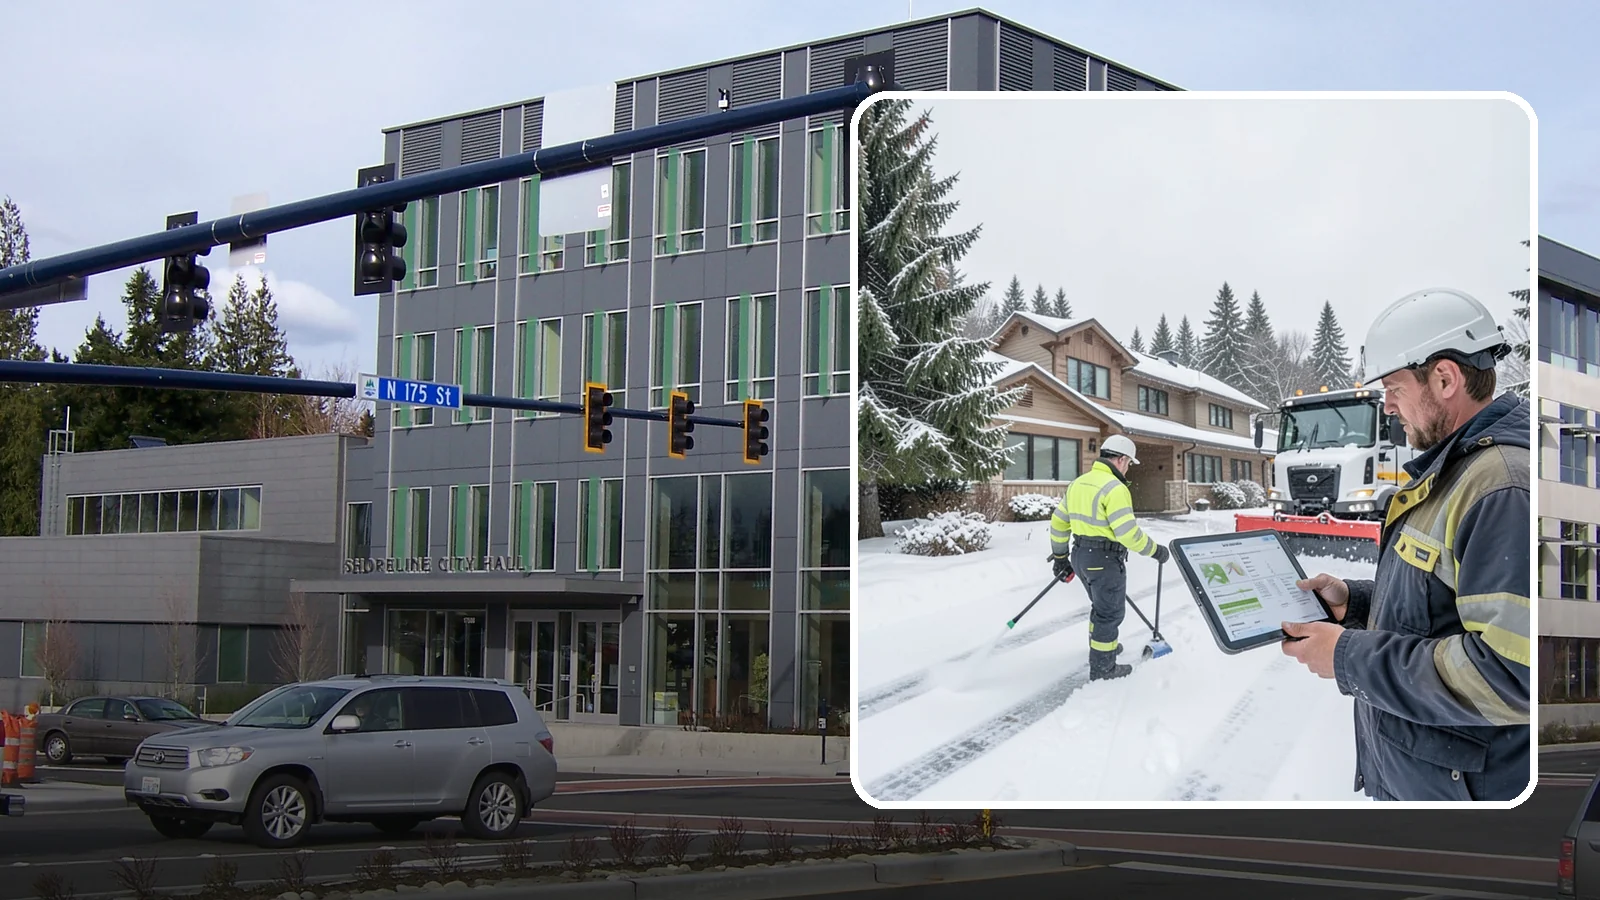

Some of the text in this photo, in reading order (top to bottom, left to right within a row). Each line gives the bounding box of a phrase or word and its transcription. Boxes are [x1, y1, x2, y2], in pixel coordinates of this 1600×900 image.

[387, 380, 451, 406] N 175 St
[343, 555, 526, 574] SHORELINE CITY HALL
